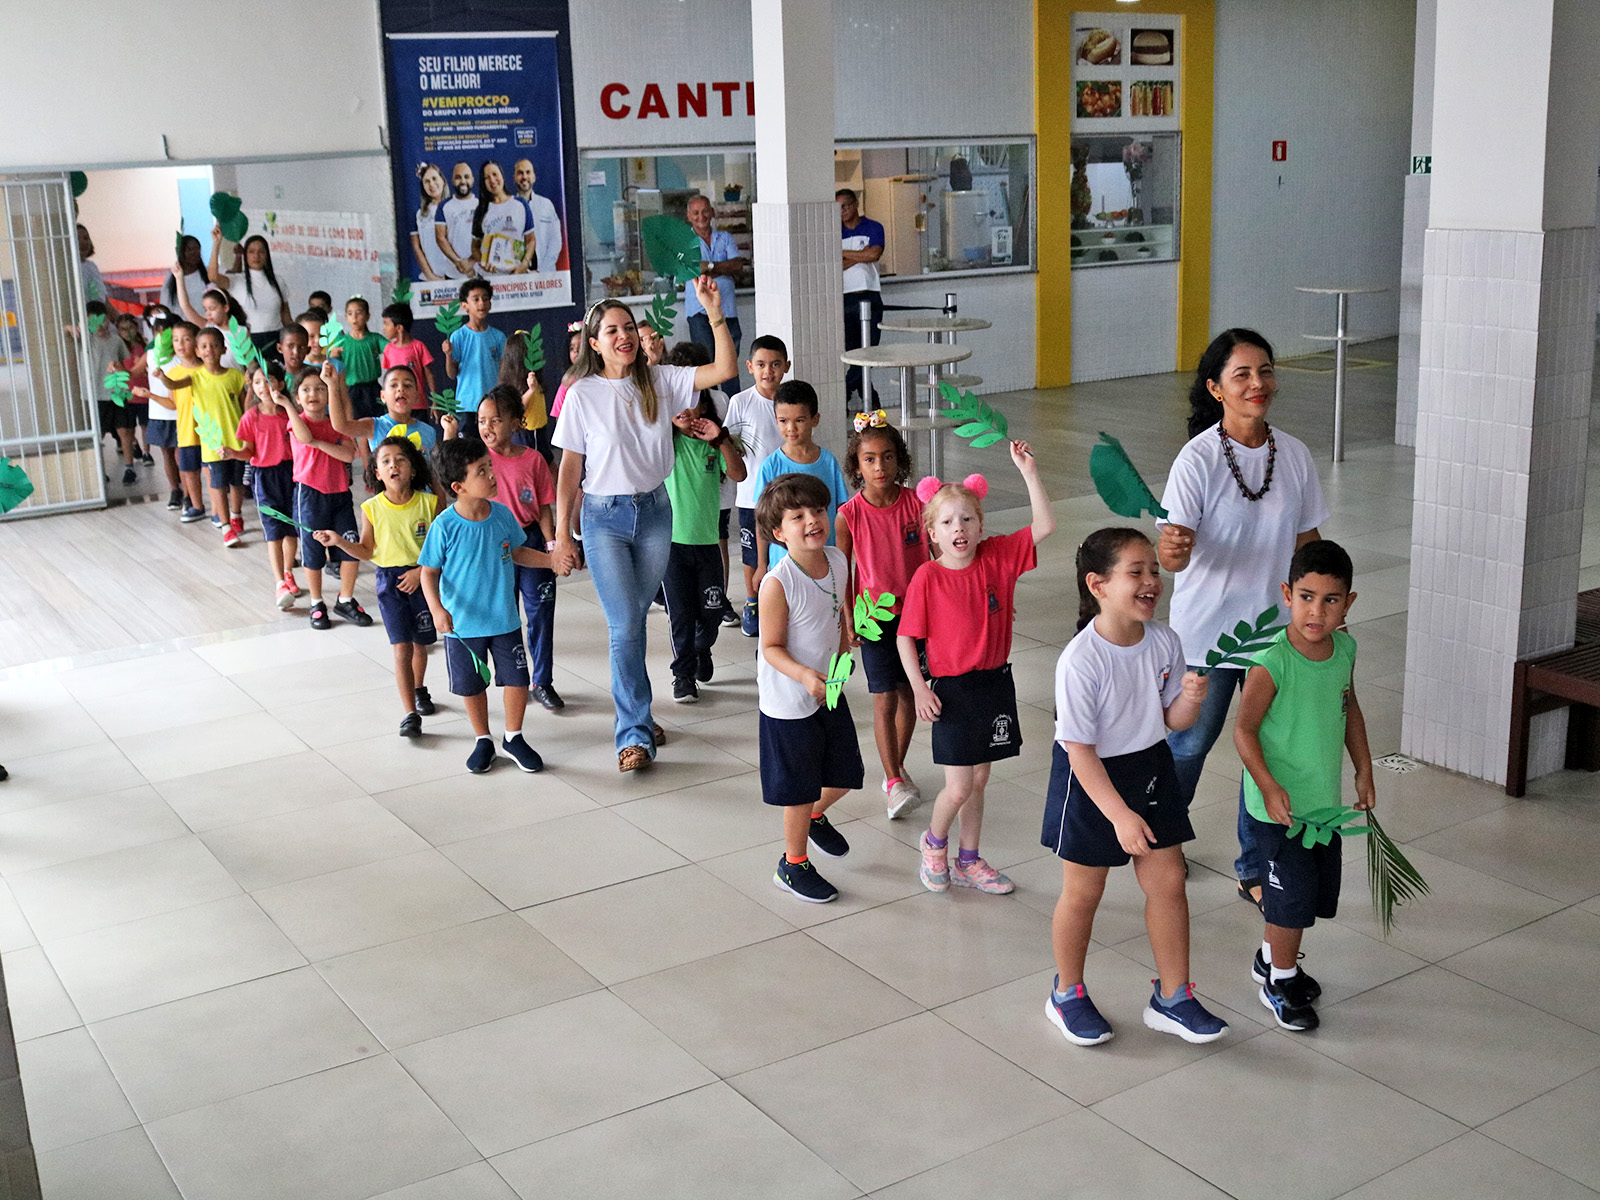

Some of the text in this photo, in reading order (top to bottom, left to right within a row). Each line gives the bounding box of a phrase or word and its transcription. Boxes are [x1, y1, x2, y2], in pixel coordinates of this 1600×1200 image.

[418, 54, 523, 73] SEU FILHO MERECE
[420, 73, 481, 90] O MELHOR!
[422, 95, 510, 108] #VEMPROCPO
[498, 106, 520, 114] MÉDIO
[434, 287, 457, 295] COLÉGIO
[493, 279, 563, 293] PRINCÍPIOS E VALORES
